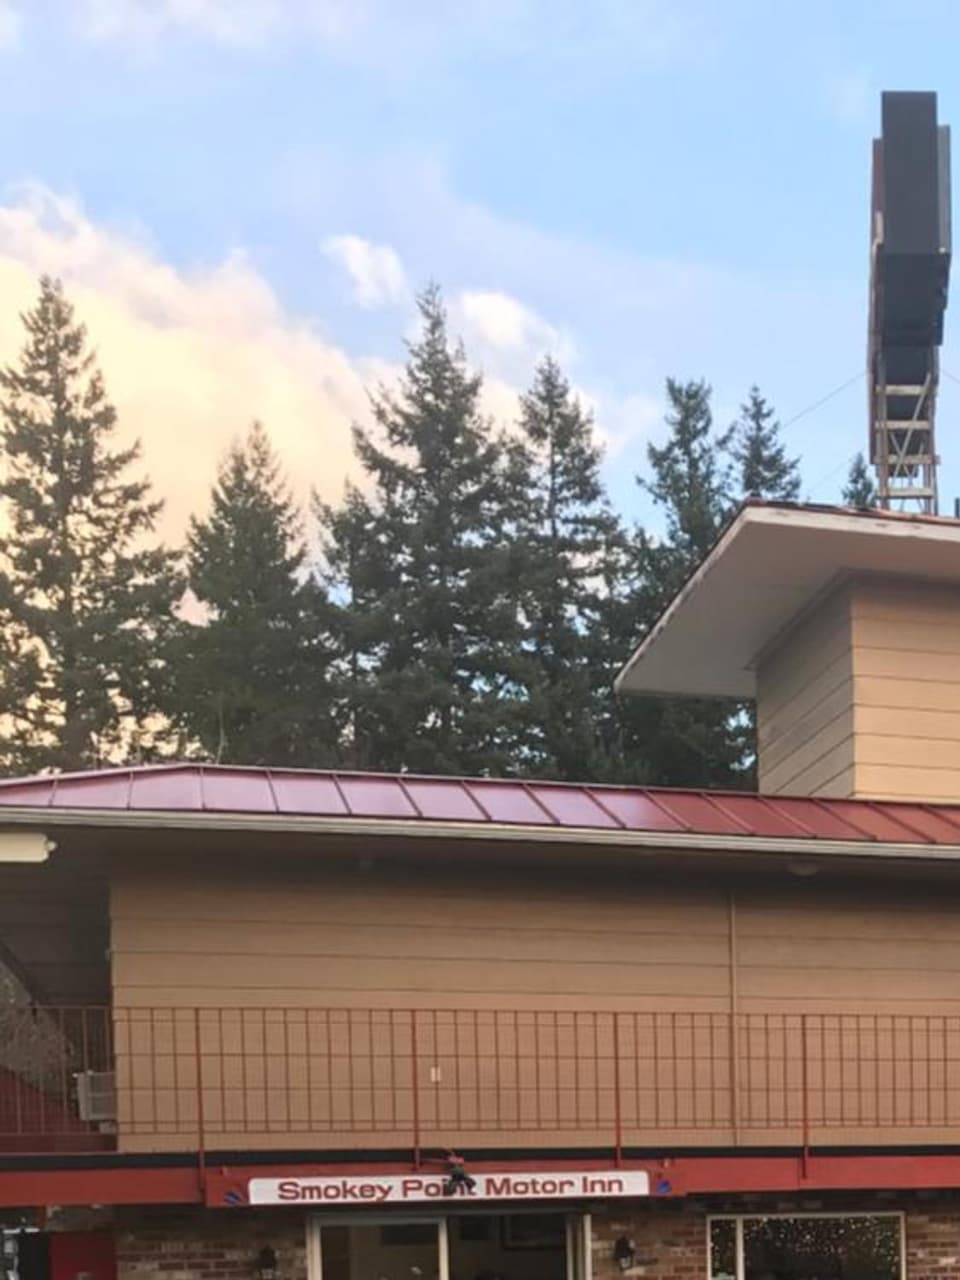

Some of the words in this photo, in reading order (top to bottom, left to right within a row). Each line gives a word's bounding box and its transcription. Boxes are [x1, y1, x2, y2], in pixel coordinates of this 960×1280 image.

[278, 1180, 392, 1202] Smokey
[485, 1177, 574, 1196] Motor
[582, 1176, 623, 1193] Inn
